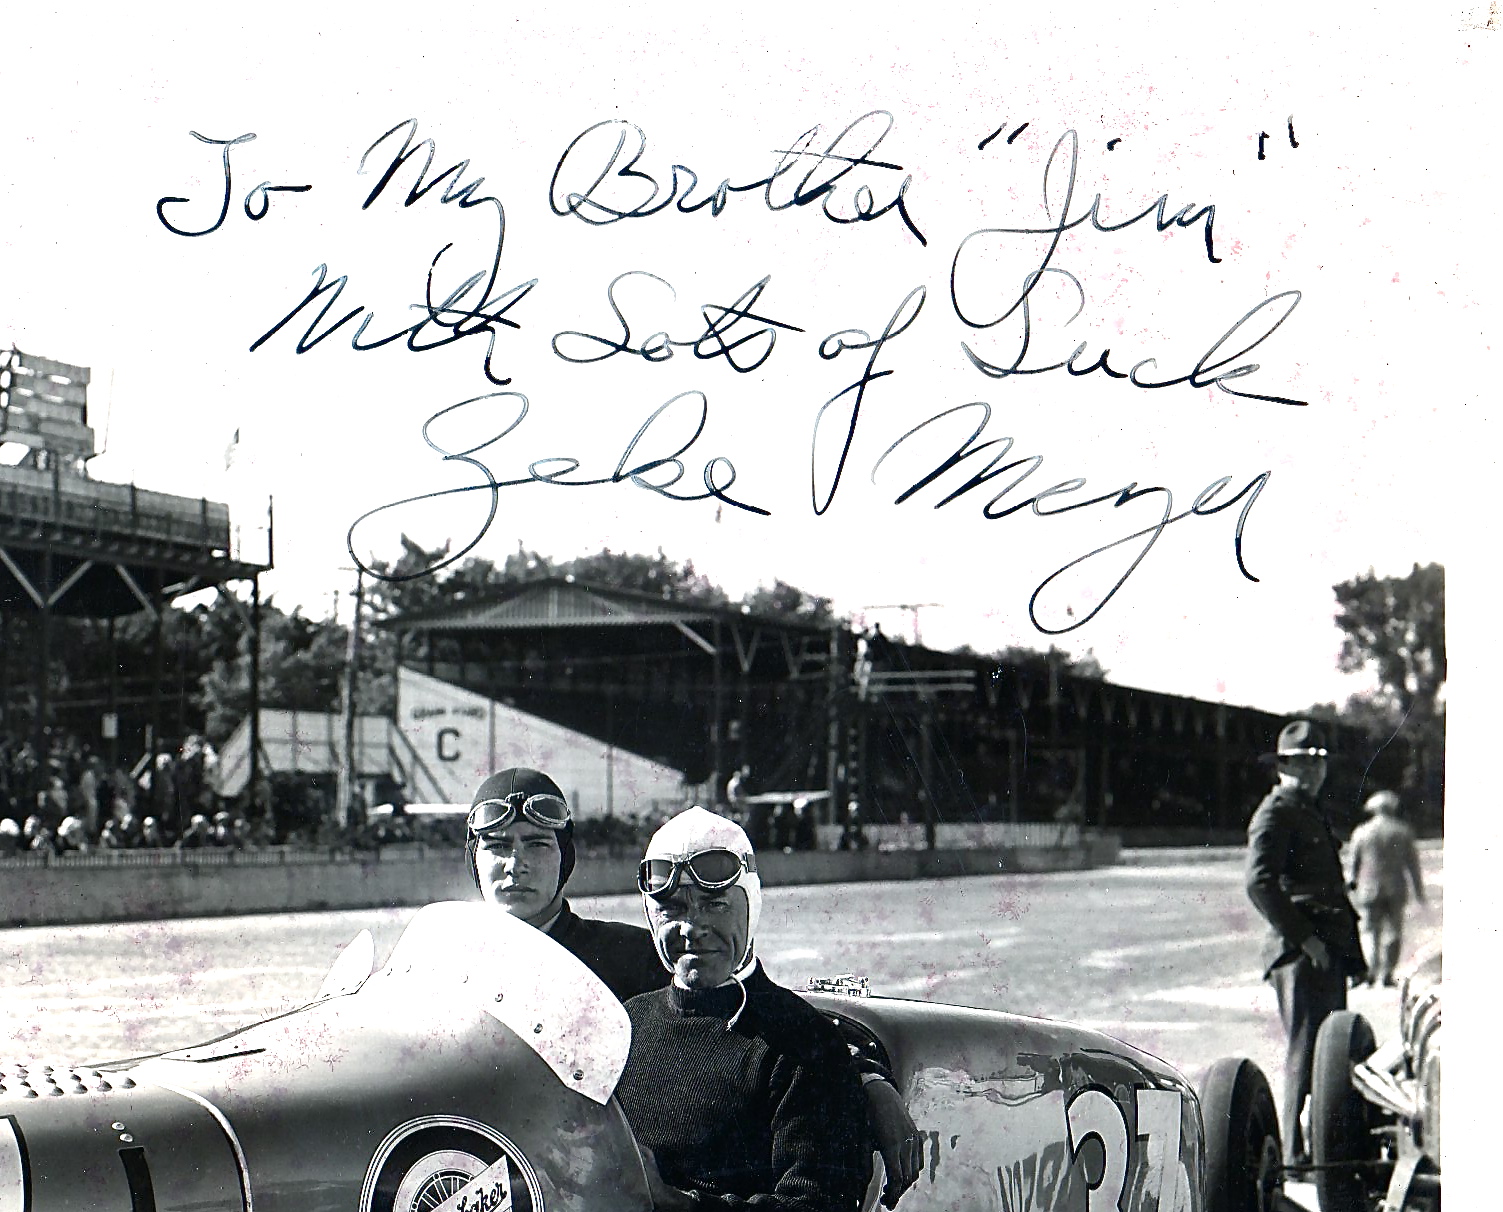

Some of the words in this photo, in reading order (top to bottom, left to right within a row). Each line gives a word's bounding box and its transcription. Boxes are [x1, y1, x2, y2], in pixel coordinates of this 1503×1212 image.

[157, 130, 313, 238] To
[360, 117, 507, 312] My
[548, 108, 929, 248] Brother
[249, 262, 540, 386] With
[552, 270, 806, 373] Lots
[818, 286, 928, 516] of
[961, 267, 1309, 407] Luck
[347, 391, 772, 582] Zeke
[872, 402, 1272, 635] Meyer
[437, 727, 461, 761] C
